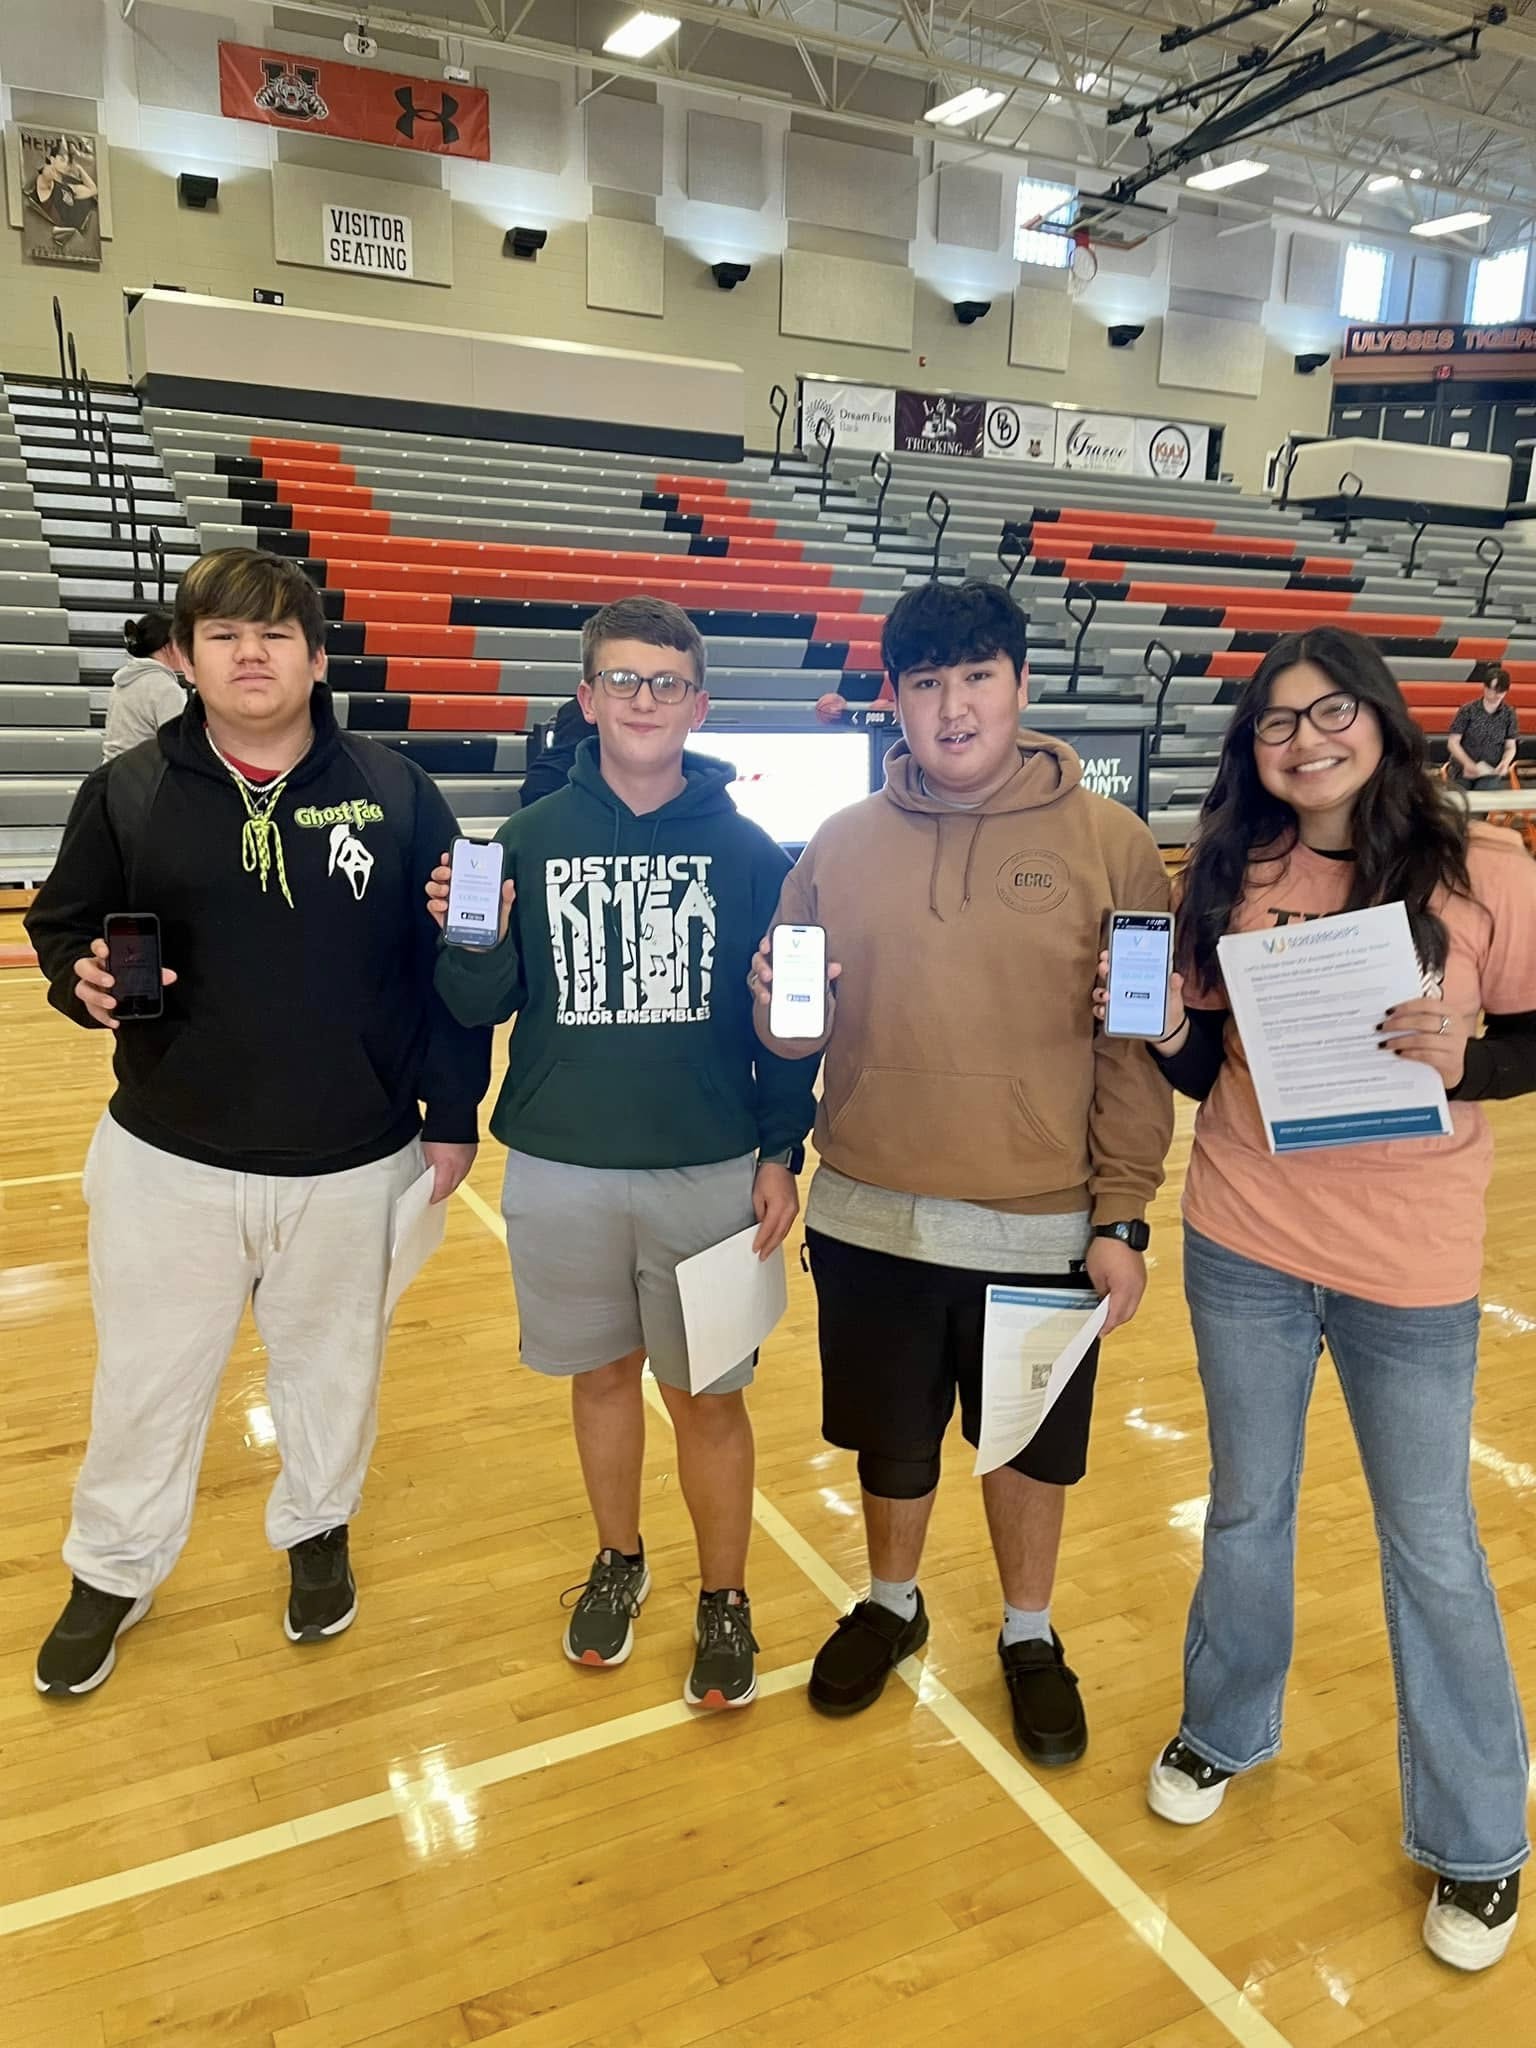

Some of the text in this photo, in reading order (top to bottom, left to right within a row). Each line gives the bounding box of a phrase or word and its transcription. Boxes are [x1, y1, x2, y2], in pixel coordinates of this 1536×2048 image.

[330, 208, 405, 243] VISITOR
[330, 238, 407, 271] SEATING
[1352, 329, 1454, 352] ULYSSES
[839, 407, 892, 424] Dream First
[905, 436, 963, 456] TRUCKING
[1079, 757, 1121, 777] ANT
[1080, 775, 1133, 796] UNTY
[294, 802, 353, 828] Ghost
[546, 854, 713, 885] DISTRICT
[546, 879, 717, 1012] KMEA
[556, 1006, 711, 1026] HONOR ENSEMBLES
